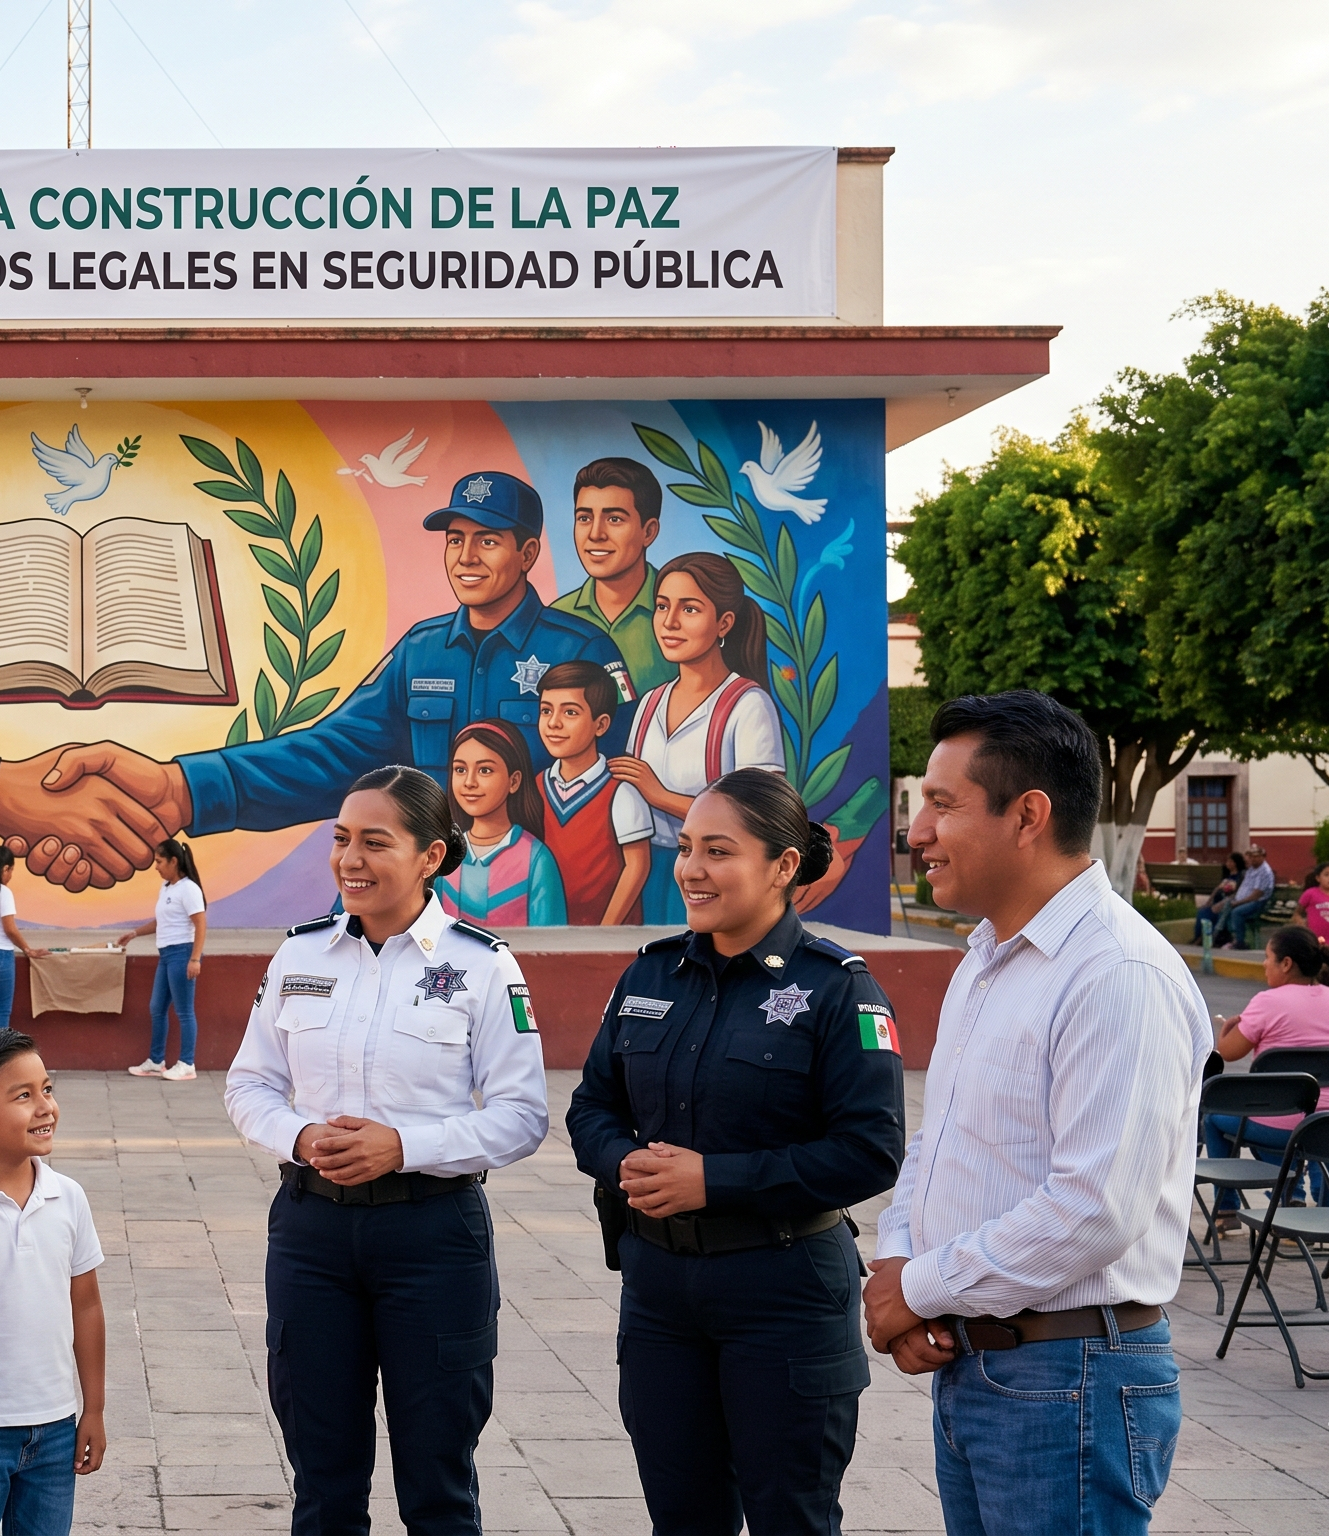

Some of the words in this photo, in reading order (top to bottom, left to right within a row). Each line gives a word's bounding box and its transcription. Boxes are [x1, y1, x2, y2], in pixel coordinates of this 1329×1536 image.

[29, 174, 412, 230] CONSTRUCCIÓN
[431, 187, 495, 229] DE
[511, 186, 572, 229] LA
[587, 186, 680, 229] PAZ
[48, 250, 238, 291] LEGALES
[252, 251, 308, 290] EN
[323, 250, 579, 290] SEGURIDAD
[594, 239, 784, 290] PÚBLICA
